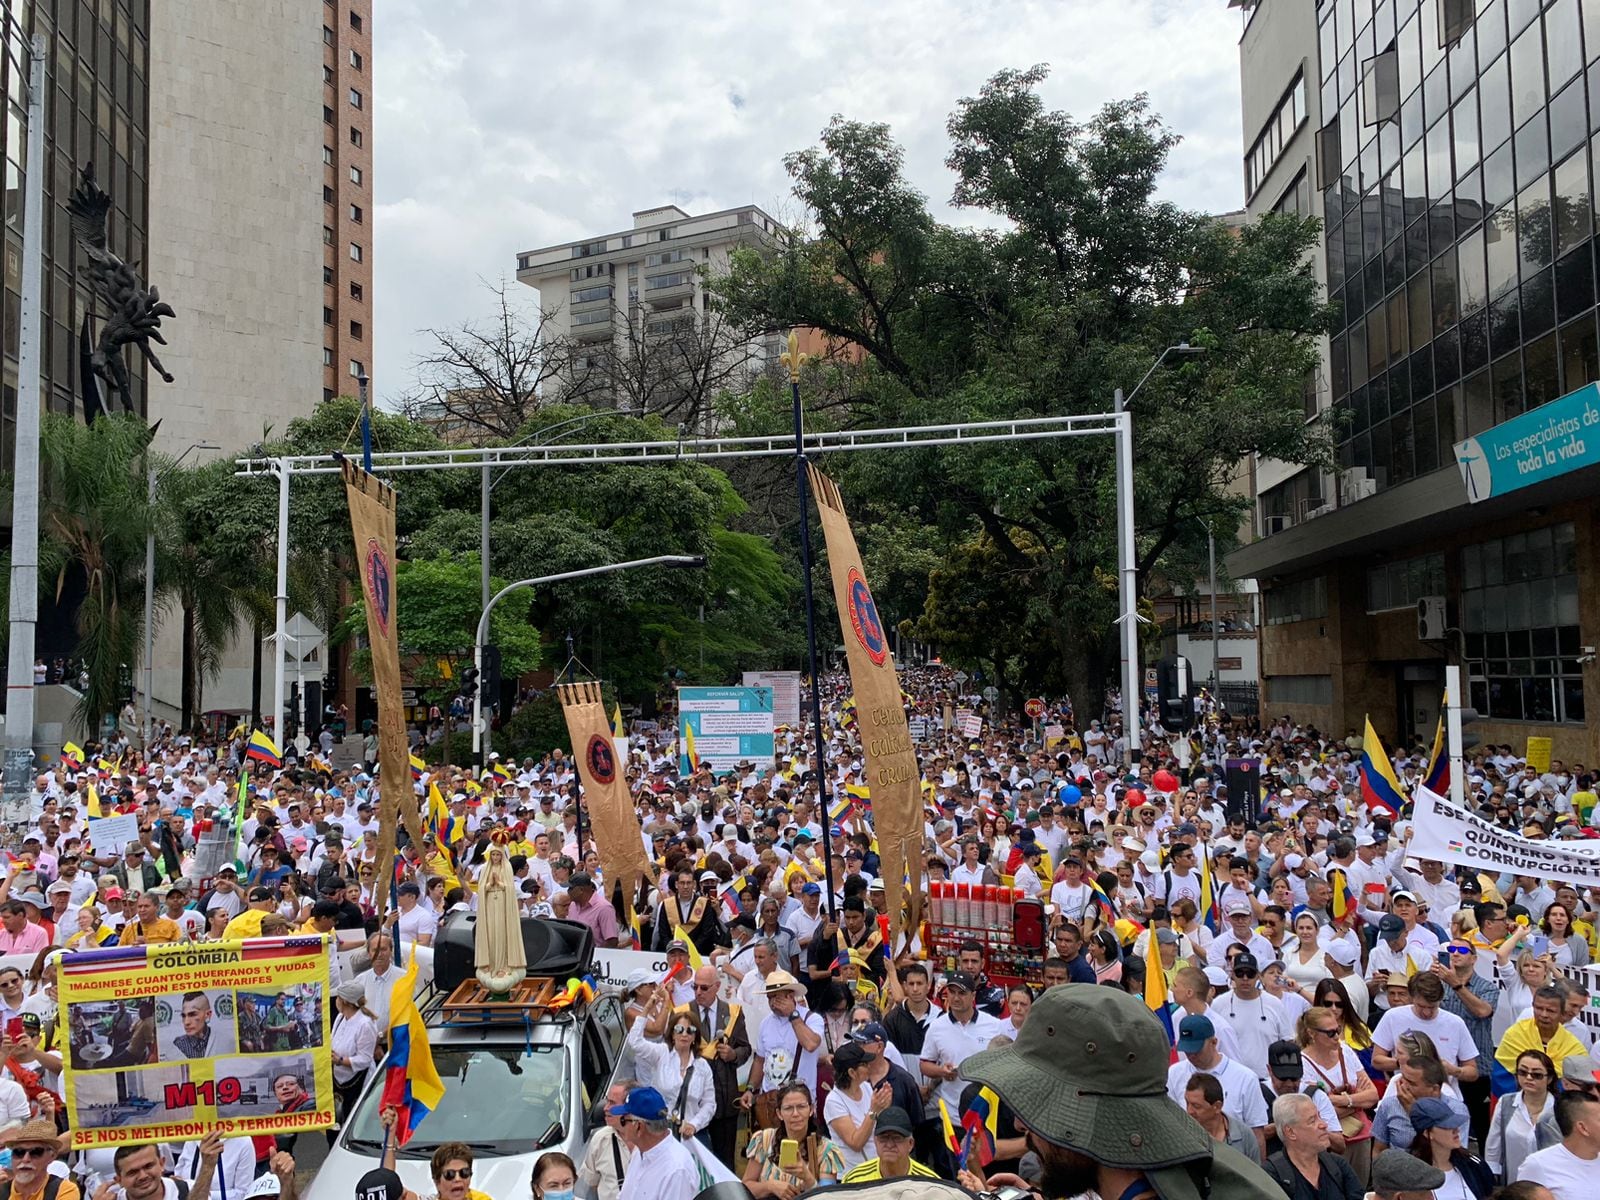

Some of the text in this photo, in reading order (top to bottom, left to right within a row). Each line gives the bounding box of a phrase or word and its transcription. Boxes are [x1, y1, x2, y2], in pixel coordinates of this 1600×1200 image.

[1493, 401, 1600, 461] Los especialistas de
[1517, 434, 1586, 475] toda la vida
[1026, 704, 1041, 712] PRE
[1433, 801, 1464, 821] ESE
[1465, 830, 1555, 861] QUINTERO
[1465, 845, 1588, 877] CORRUPCIÓN
[69, 961, 316, 991] IMAGINESE CUANTOS HUERFANOS Y VIUDAS
[153, 952, 239, 969] COLOMBIA
[114, 975, 272, 997] DEJARON ESTOS MATARIFES
[164, 1076, 241, 1110] M19
[75, 1131, 93, 1144] SE
[98, 1129, 127, 1142] NOS
[131, 1122, 204, 1140] METIERON
[238, 1111, 332, 1131] TERRORISTAS
